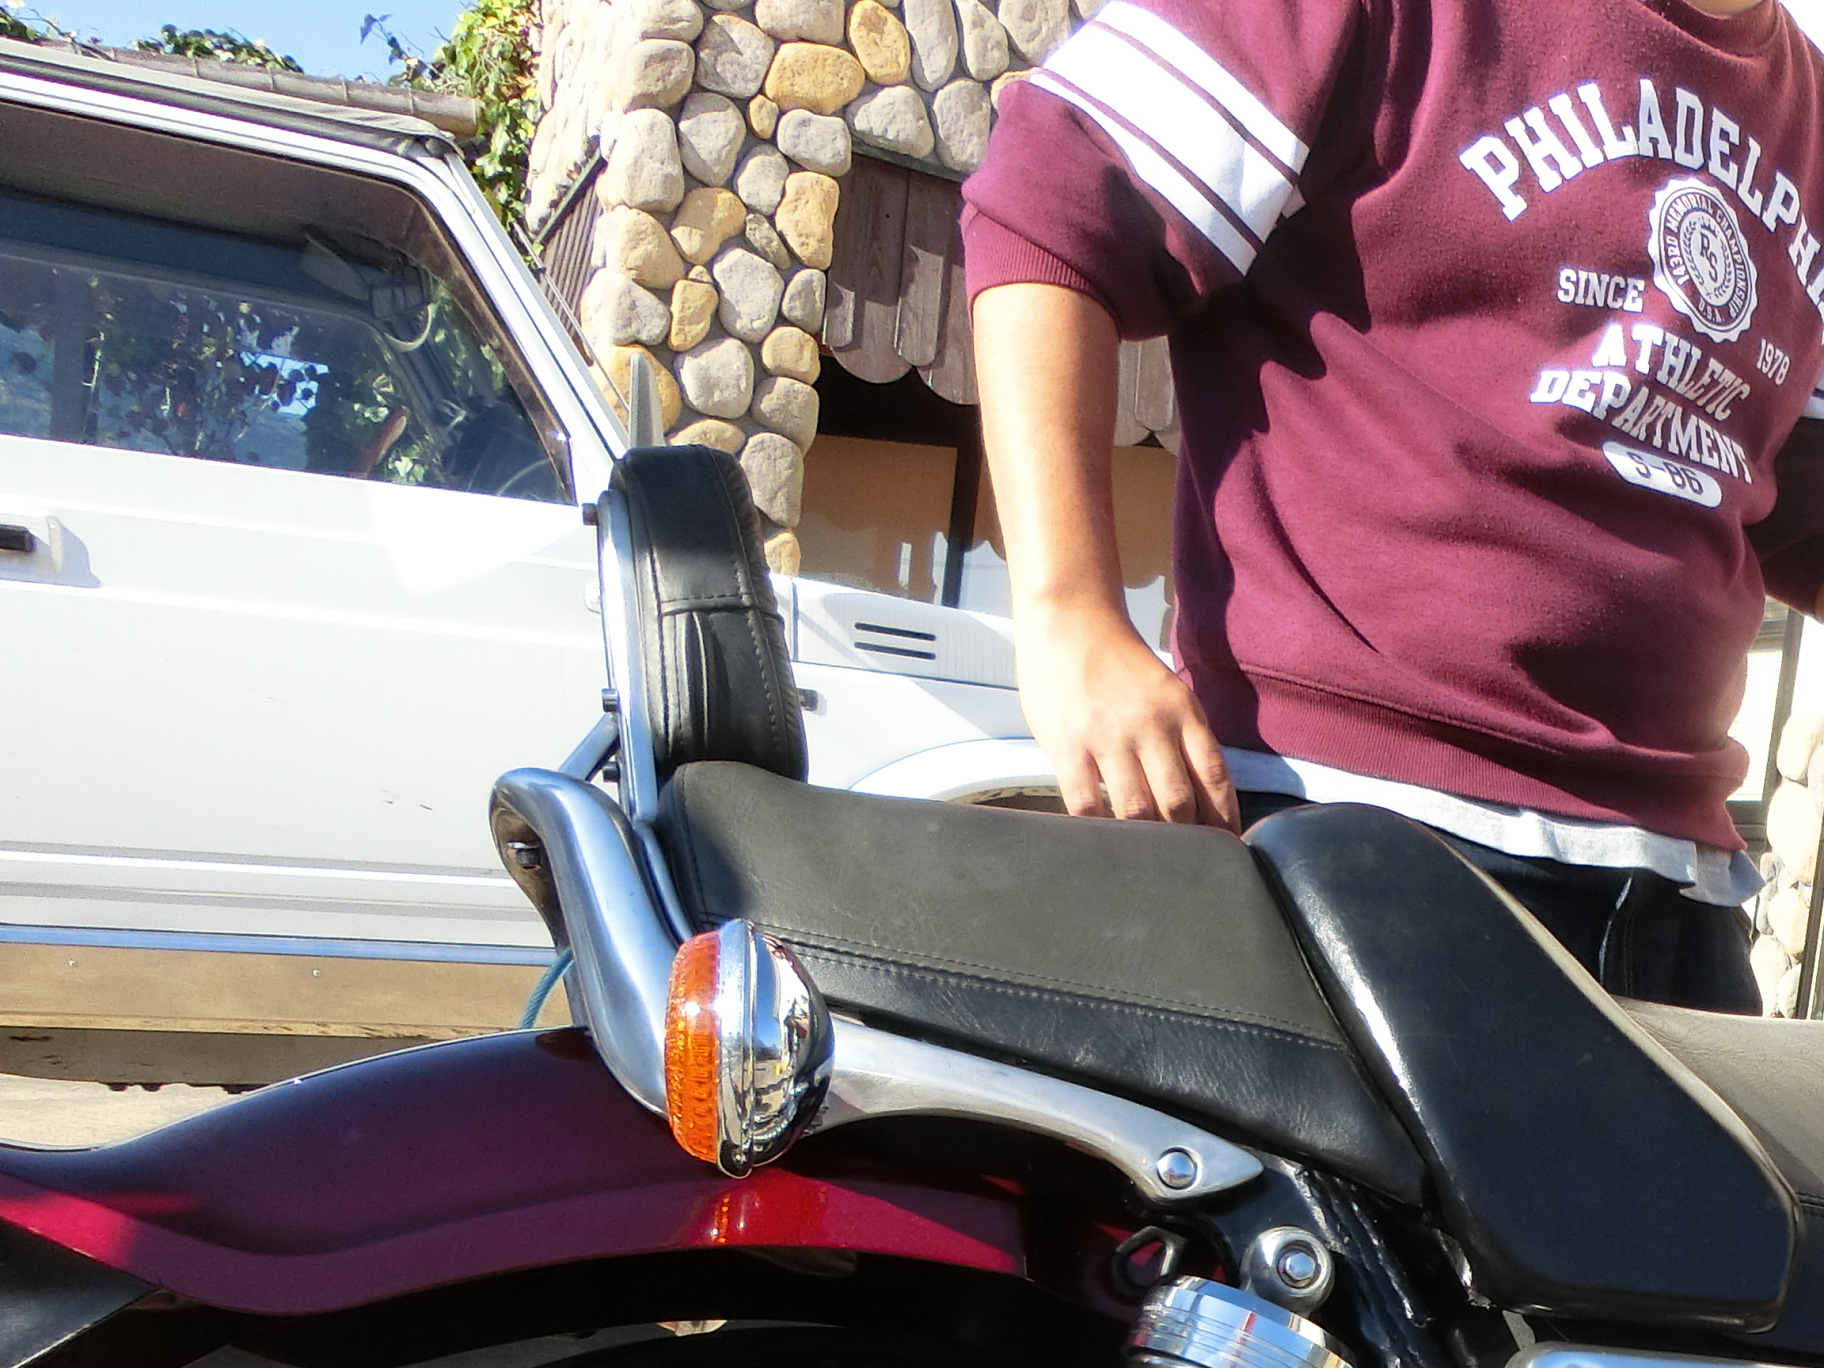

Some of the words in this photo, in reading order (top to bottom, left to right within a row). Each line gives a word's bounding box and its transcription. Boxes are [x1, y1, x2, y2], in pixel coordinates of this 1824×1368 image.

[1557, 267, 1646, 313] SINCE
[1666, 193, 1714, 233] MEMORIAL
[1715, 209, 1748, 319] CHAMPIONSHIP
[1592, 319, 1752, 421] ATHLETIC
[1756, 338, 1791, 386] 1978
[1530, 369, 1753, 485] DEPARTMENT
[1626, 451, 1704, 496] S-86
